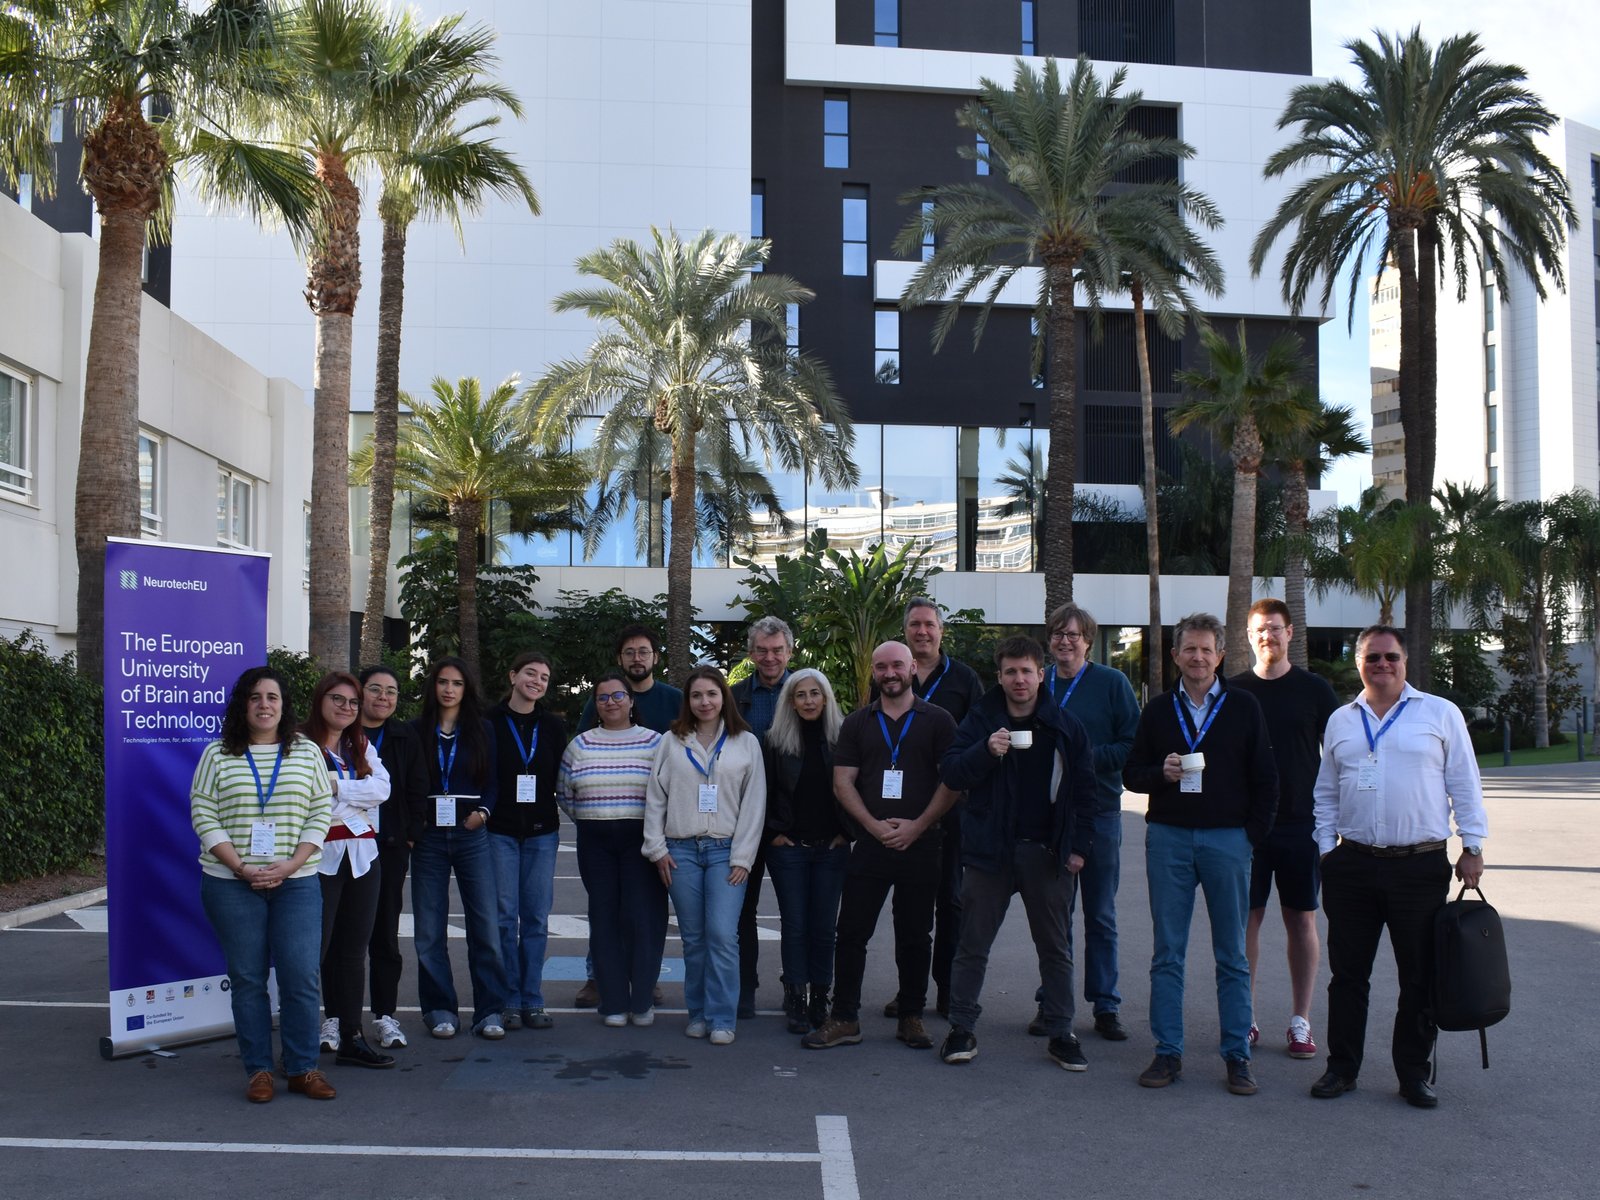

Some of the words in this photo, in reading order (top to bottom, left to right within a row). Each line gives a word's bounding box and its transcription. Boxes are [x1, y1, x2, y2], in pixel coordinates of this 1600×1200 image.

[143, 576, 208, 591] NeurotechEU
[120, 632, 157, 652] The
[161, 634, 244, 658] European
[121, 658, 210, 683] University
[121, 684, 141, 703] of
[145, 685, 188, 704] Brain
[193, 687, 226, 704] and
[121, 710, 226, 734] Technology
